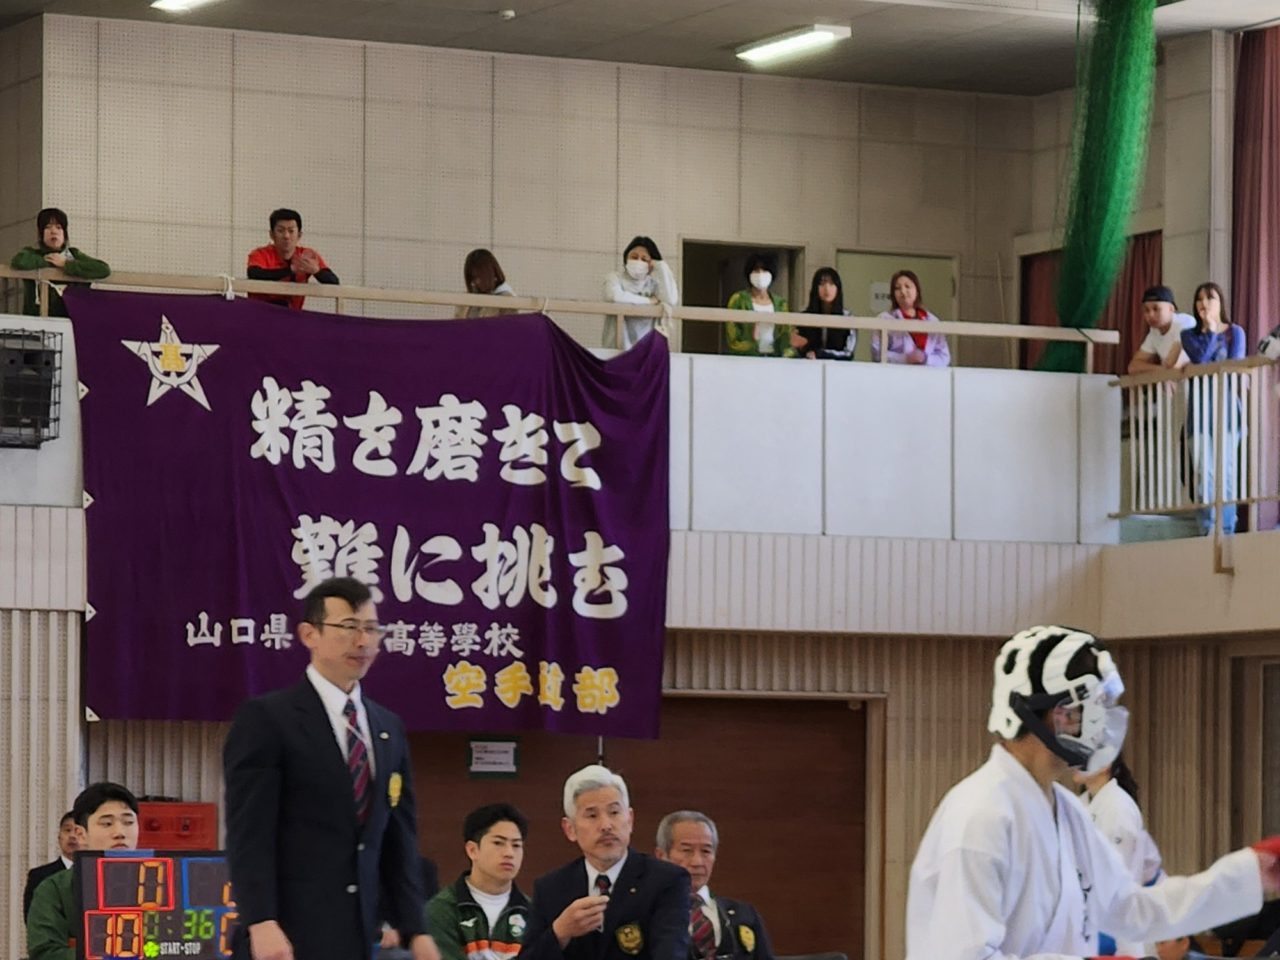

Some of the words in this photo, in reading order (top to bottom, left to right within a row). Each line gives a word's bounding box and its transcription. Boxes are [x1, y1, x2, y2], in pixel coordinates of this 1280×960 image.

[249, 376, 602, 491] 精を磨きて
[290, 513, 630, 619] 難に挑む
